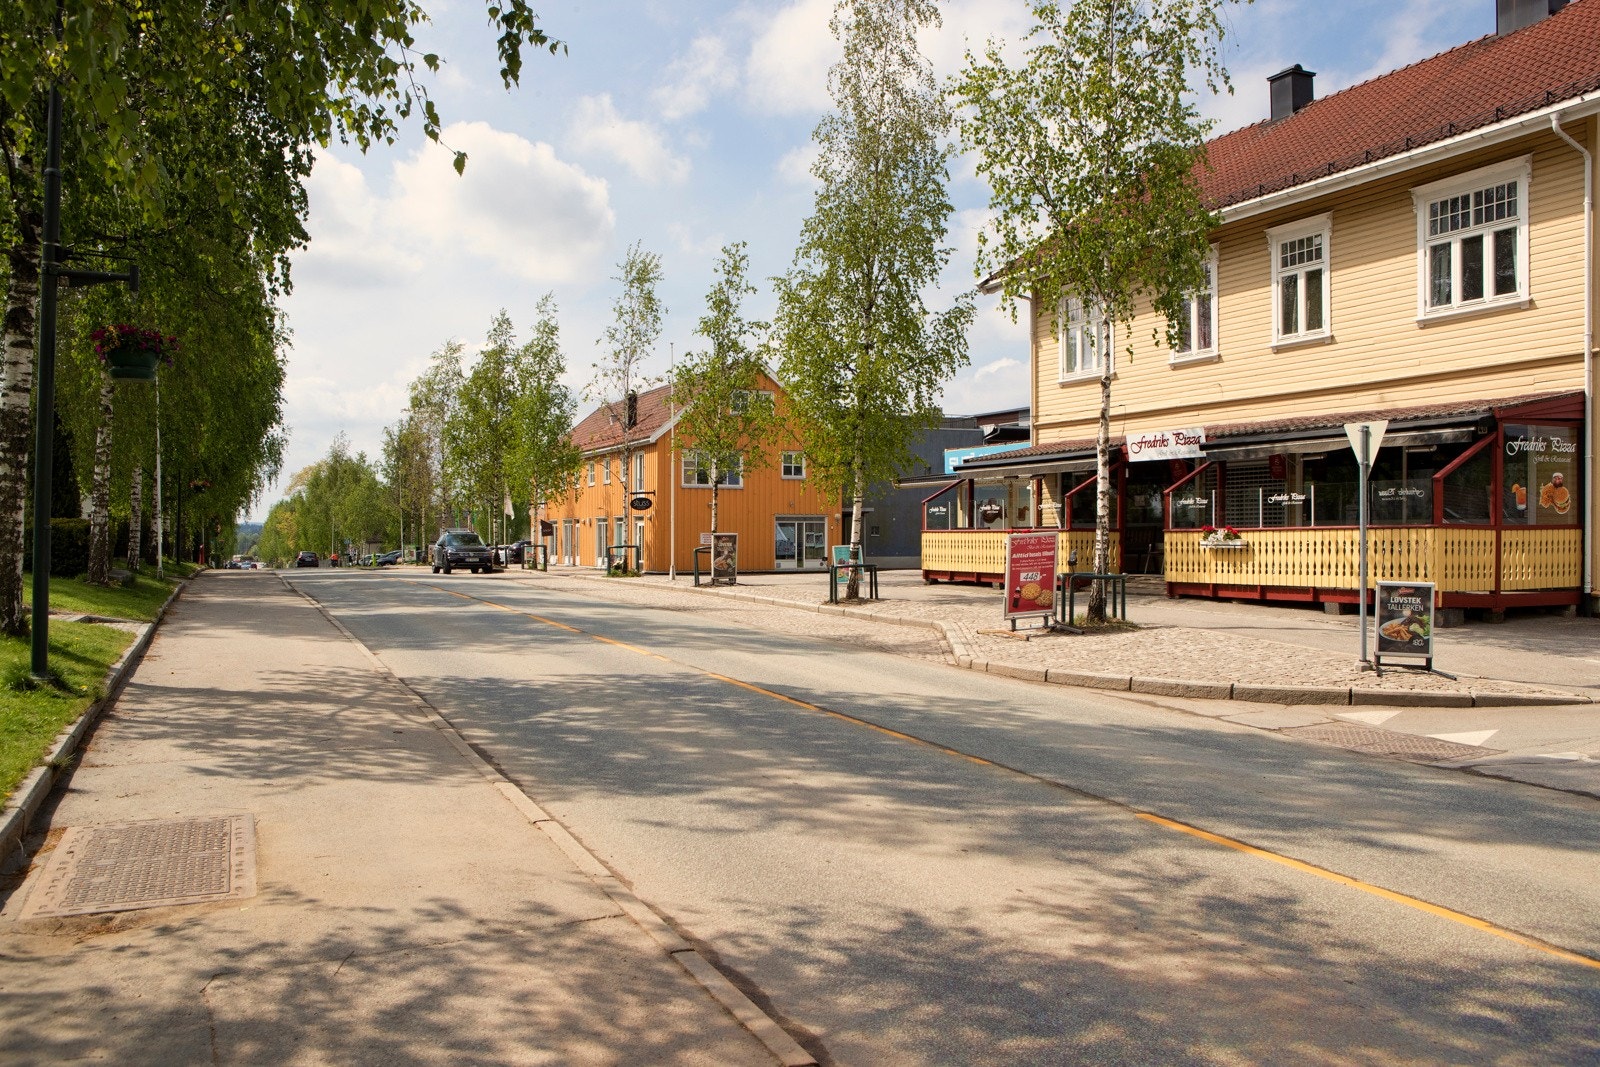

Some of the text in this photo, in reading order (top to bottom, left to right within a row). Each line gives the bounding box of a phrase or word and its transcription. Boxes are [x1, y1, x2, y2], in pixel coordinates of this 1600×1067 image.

[1130, 434, 1170, 454] Fredriks
[1172, 432, 1202, 447] Pizza
[1506, 435, 1577, 456] Fredriks Pizza
[1390, 596, 1421, 604] LØVSTEK
